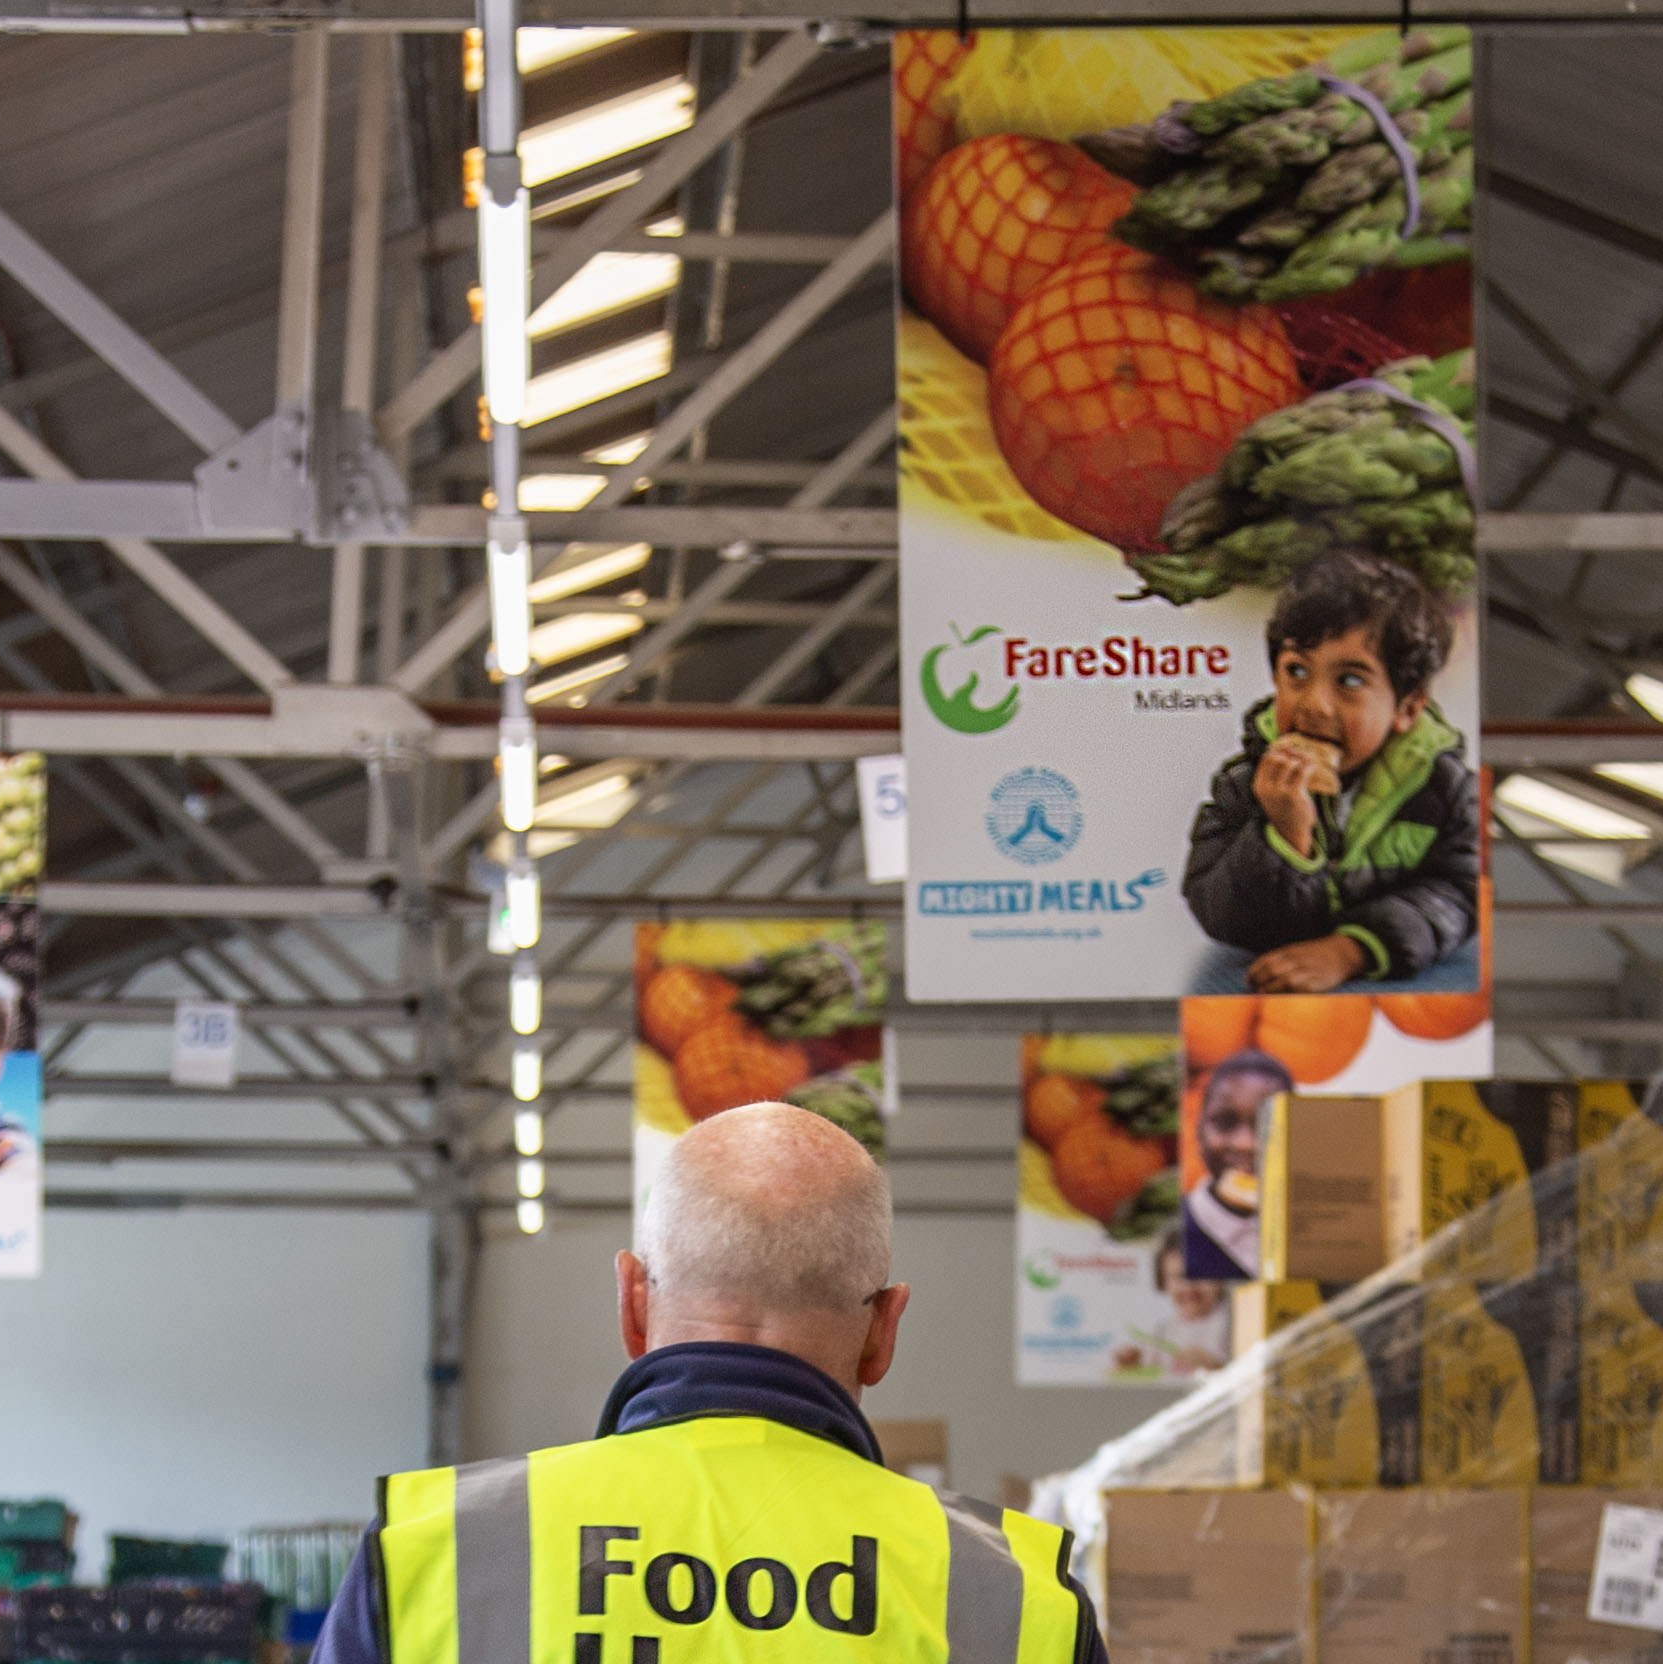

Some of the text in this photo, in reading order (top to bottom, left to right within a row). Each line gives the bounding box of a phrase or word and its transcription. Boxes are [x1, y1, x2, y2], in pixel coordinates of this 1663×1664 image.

[1004, 636, 1230, 678] FareShare
[1135, 689, 1231, 711] Midlands
[1038, 876, 1148, 912] MEALS
[576, 1525, 878, 1636] Food
